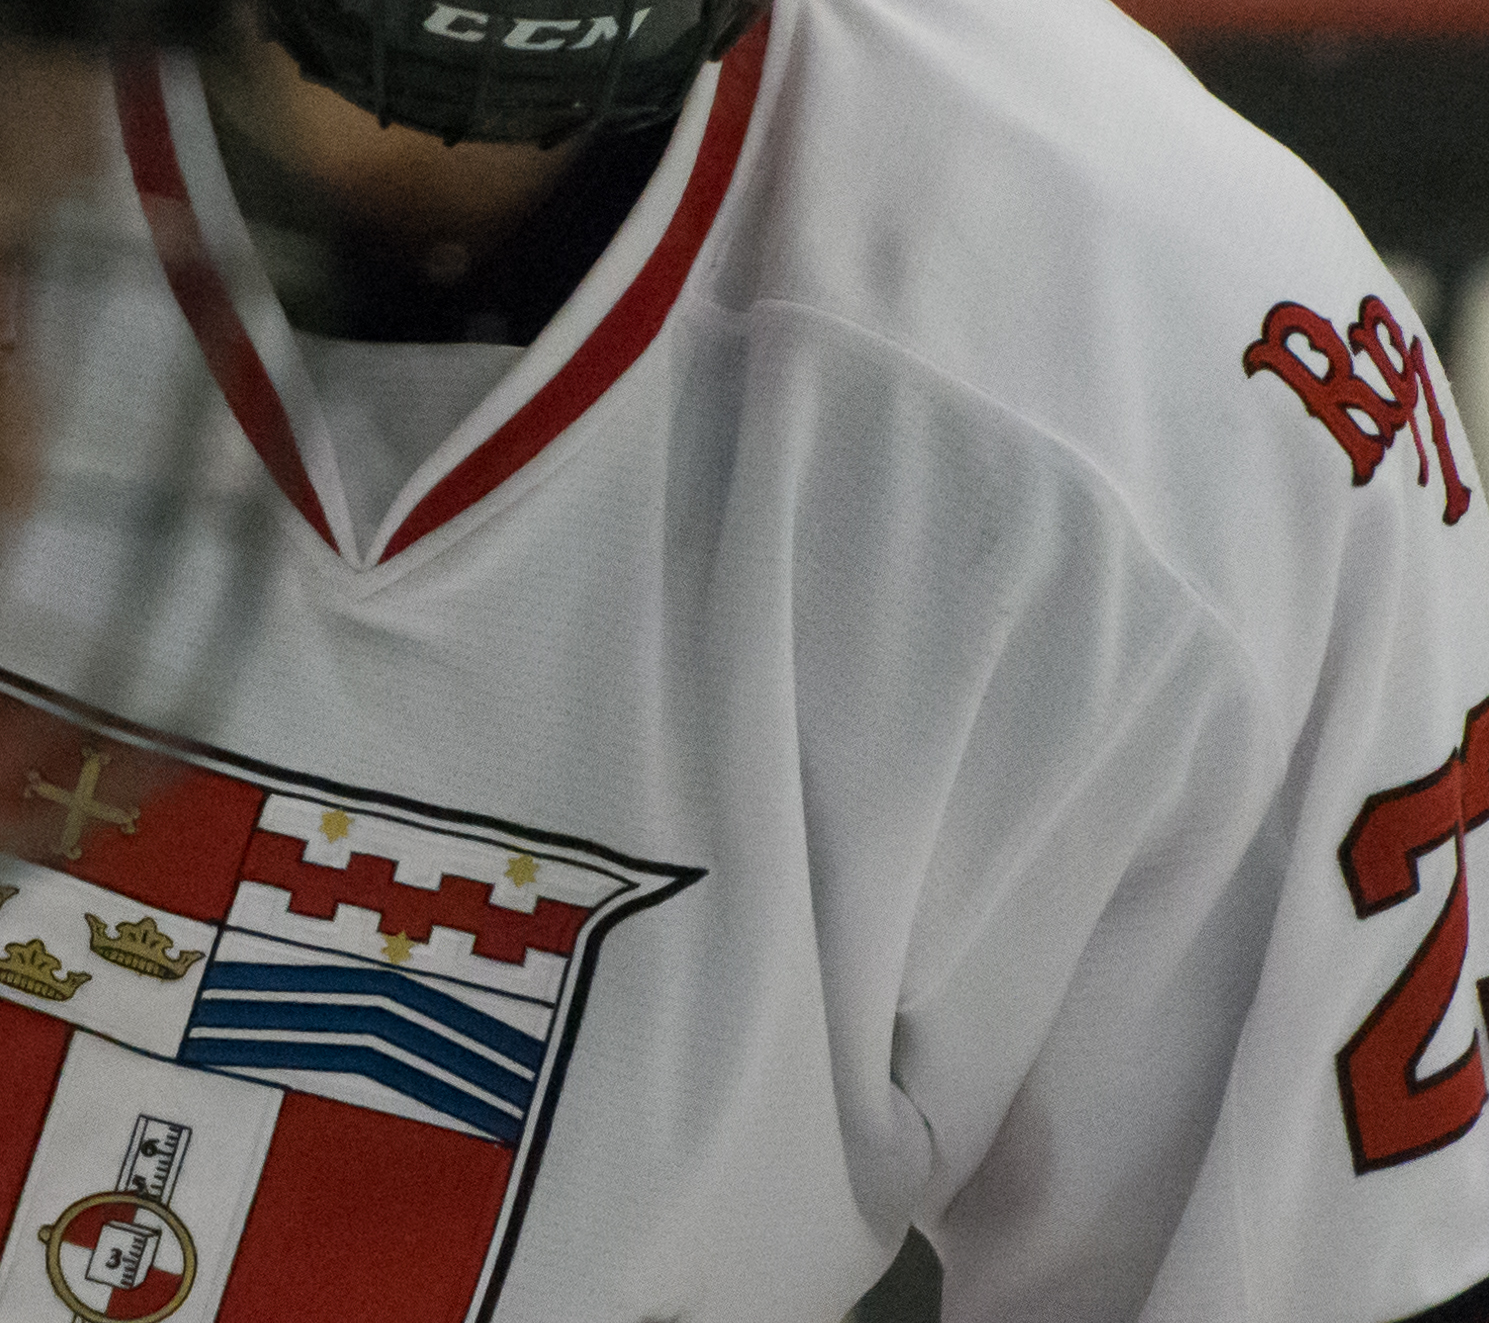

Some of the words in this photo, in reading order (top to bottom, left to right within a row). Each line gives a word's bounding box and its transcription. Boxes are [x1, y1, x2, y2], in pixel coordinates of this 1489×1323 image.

[424, 2, 652, 51] CCM
[1242, 294, 1472, 527] RPI
[105, 1246, 123, 1270] 3
